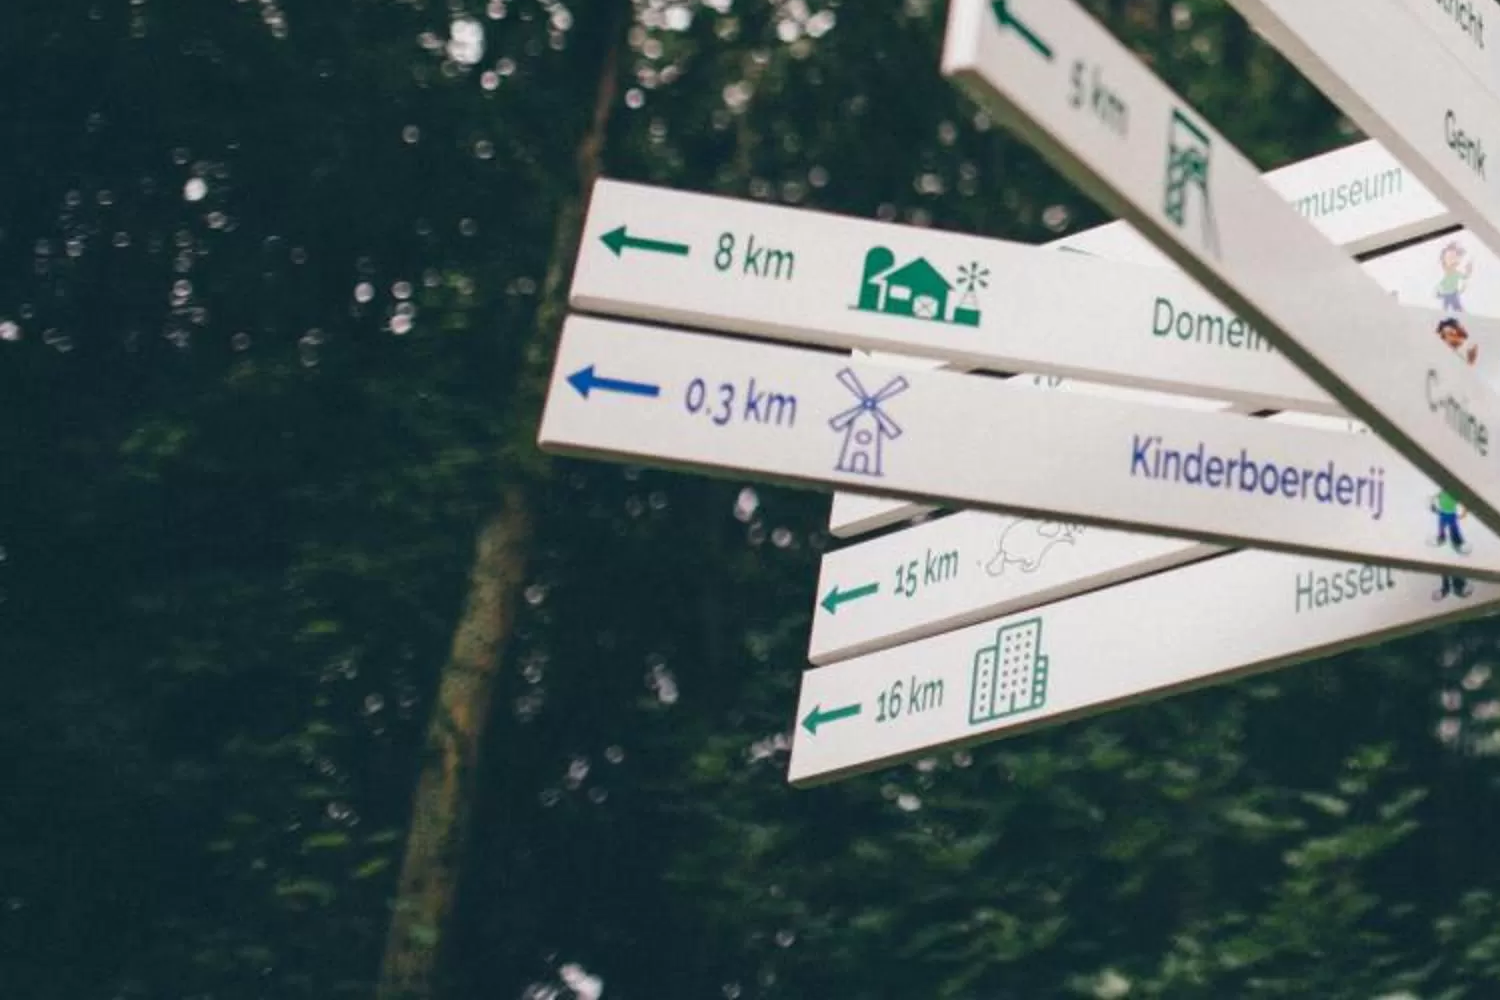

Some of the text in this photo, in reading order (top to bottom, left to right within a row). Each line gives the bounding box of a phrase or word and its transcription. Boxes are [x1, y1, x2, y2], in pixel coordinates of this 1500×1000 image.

[1068, 60, 1129, 138] 5 km
[1444, 108, 1487, 183] Genk
[1291, 167, 1402, 217] museum
[714, 231, 795, 282] 8 km
[685, 376, 797, 429] 0.3 km
[1130, 434, 1386, 521] Kinderboerderij
[894, 548, 959, 598] 15 km
[876, 675, 945, 723] 16 km
